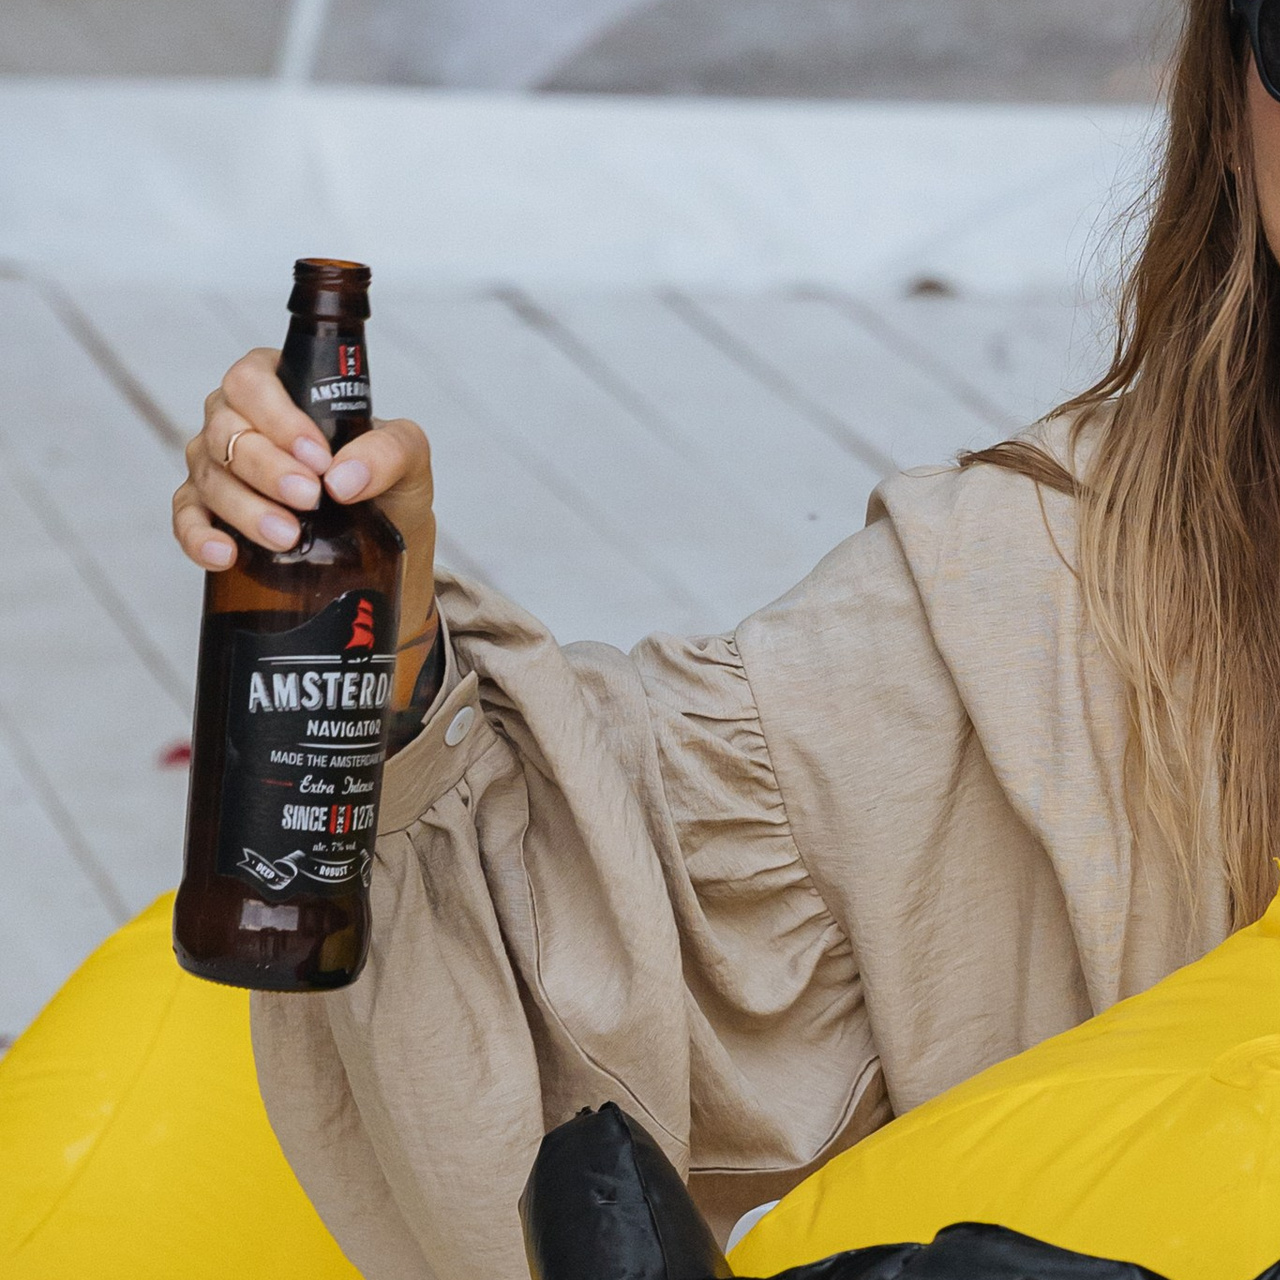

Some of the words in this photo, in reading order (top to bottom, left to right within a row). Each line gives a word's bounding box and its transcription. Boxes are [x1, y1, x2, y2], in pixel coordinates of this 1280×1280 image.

[306, 719, 381, 738] NAVIGATOR
[270, 750, 304, 766] MADE
[307, 754, 328, 768] THE
[299, 775, 335, 794] Extra
[281, 803, 328, 832] SINCE
[352, 804, 376, 831] 1275
[256, 862, 275, 880] DEEP
[319, 864, 349, 877] ROBUST
